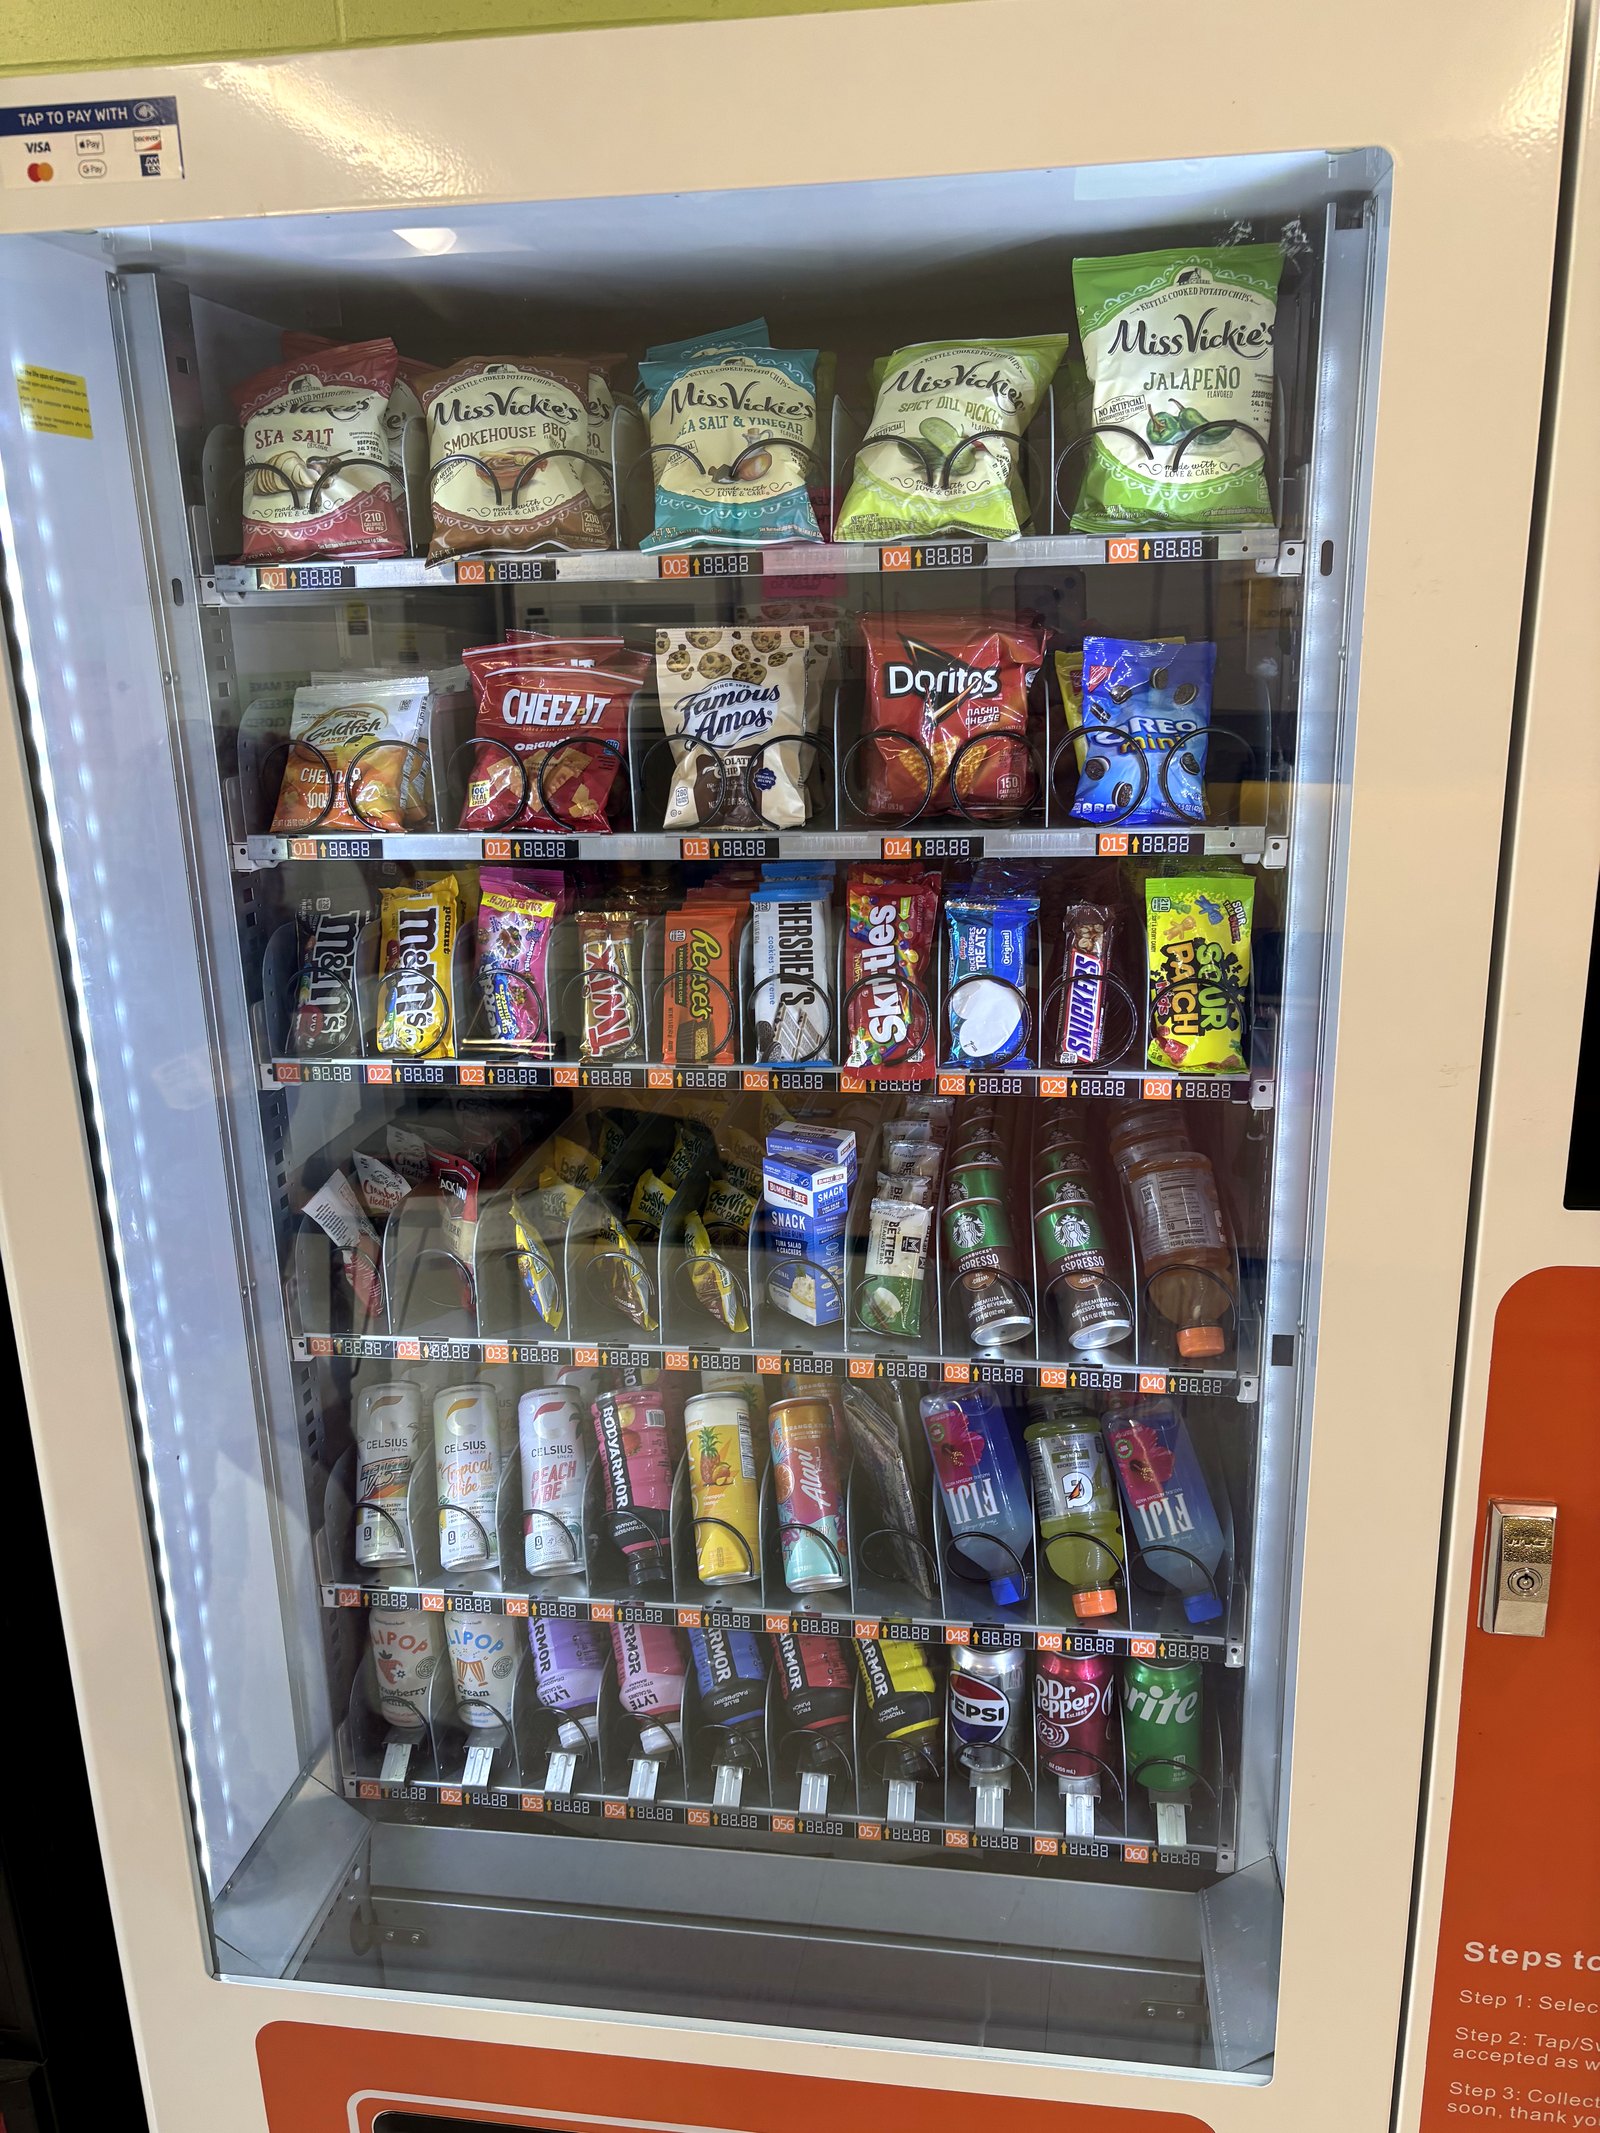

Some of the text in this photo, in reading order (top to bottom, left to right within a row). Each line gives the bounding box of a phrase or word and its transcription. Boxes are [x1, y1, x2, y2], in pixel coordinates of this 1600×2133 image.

[18, 106, 129, 127] TAP TO PAY WITH
[25, 141, 52, 154] VISA
[86, 141, 100, 150] Pay
[1140, 287, 1252, 312] KETTLE COOKED POTATO CHIPS
[1107, 305, 1274, 358] Miss Vickie's
[882, 367, 952, 396] Miss
[1143, 365, 1241, 392] JALAPEÑO
[670, 380, 814, 426] Miss Vickie's
[1206, 390, 1234, 400] FLAVORED
[434, 386, 580, 426] Miss Vickie's
[897, 396, 1003, 426] SPICY DILL PICKLE
[1098, 397, 1145, 418] NO ARTIFICIAL
[698, 415, 729, 432] SALT
[732, 415, 746, 428] &
[747, 416, 804, 437] VINEGAR
[254, 428, 334, 450] SEA SALT
[443, 422, 567, 459] SMOKEHOUSE BBQ
[365, 512, 382, 523] 210
[882, 546, 973, 566] 004 88.88
[1109, 539, 1203, 560] 005 88.88
[459, 562, 542, 580] 002 88.88
[663, 556, 749, 574] 003 88.88
[262, 570, 342, 587] 001 88.88
[888, 664, 999, 694] Doritos
[502, 687, 612, 727] CHEEZ-IT
[673, 682, 782, 732] Famous
[307, 718, 381, 743] Goldfish
[684, 705, 773, 752] Amos
[1094, 715, 1198, 746] OREO
[1001, 776, 1019, 789] 150
[293, 841, 370, 858] 011 88.88
[486, 841, 566, 858] 012 88.88
[684, 840, 766, 857] 013 88.88
[884, 839, 970, 856] 014 88.88
[1100, 836, 1190, 854] 015 88.88
[1161, 897, 1170, 911] 210
[1233, 900, 1247, 927] SOUR
[441, 904, 452, 956] peanut
[523, 940, 536, 972] rainbow
[767, 935, 776, 965] cookies
[777, 902, 816, 1006] HERSHEY'S
[968, 926, 977, 972] RICE KRISPIES
[975, 927, 988, 969] TREATS
[1003, 930, 1012, 965] Original
[395, 904, 440, 1030] m&m's
[689, 928, 723, 1020] Reese's
[861, 904, 908, 1044] Skittles
[1166, 941, 1199, 1036] PATCH
[583, 947, 633, 1057] TWIX
[1067, 954, 1100, 1058] SNICKERS
[277, 1066, 300, 1081] 021
[368, 1067, 392, 1081] 022
[461, 1069, 485, 1083] 023
[555, 1070, 579, 1084] 024
[650, 1072, 673, 1086] 025
[745, 1074, 769, 1087] 026
[841, 1077, 866, 1090] 027
[940, 1078, 966, 1092] 028
[1041, 1080, 1067, 1095] 029
[1145, 1082, 1171, 1096] 030
[768, 1183, 808, 1205] BUMBLE BEE
[818, 1184, 844, 1203] SNACK
[771, 1211, 806, 1231] SNACK
[775, 1239, 802, 1250] TUNA SALAD
[883, 1221, 900, 1265] BETTER
[958, 1253, 1000, 1273] ESPRESSO
[1060, 1256, 1105, 1273] ESPRESSO
[397, 1342, 421, 1357] 032
[486, 1348, 509, 1360] 033
[575, 1350, 599, 1364] 034
[666, 1354, 690, 1368] 035
[757, 1357, 781, 1371] 036
[851, 1360, 875, 1375] 037
[945, 1366, 970, 1380] 038
[1041, 1370, 1067, 1385] 039
[1140, 1376, 1166, 1390] 040
[366, 1438, 408, 1450] CELSIUS
[444, 1440, 487, 1455] CELSIUS
[531, 1445, 573, 1457] CELSIUS
[602, 1405, 629, 1509] BODYARMOR
[441, 1453, 493, 1484] Tropical
[530, 1460, 577, 1489] PEACH
[800, 1446, 832, 1508] Alani
[446, 1476, 480, 1499] Vibe
[530, 1481, 563, 1508] VIBE
[946, 1477, 1001, 1525] FIJI
[1137, 1493, 1195, 1542] FIJI
[422, 1596, 445, 1609] 042
[506, 1601, 529, 1614] 043
[591, 1606, 614, 1620] 044
[678, 1611, 701, 1625] 045
[766, 1617, 789, 1631] 046
[855, 1623, 878, 1637] 047
[945, 1629, 969, 1644] 048
[1038, 1634, 1062, 1649] 049
[1131, 1640, 1156, 1655] 050
[457, 1683, 491, 1698] Cream
[543, 1688, 571, 1706] LYTE
[1035, 1674, 1095, 1720] Pepper
[1048, 1678, 1077, 1702] Dr
[628, 1693, 660, 1711] LYTE
[1127, 1685, 1198, 1725] rite
[1041, 1722, 1055, 1741] 23
[441, 1790, 463, 1803] 052
[522, 1797, 544, 1810] 053
[604, 1804, 627, 1818] 054
[688, 1811, 711, 1824] 055
[772, 1818, 795, 1831] 056
[859, 1825, 881, 1838] 057
[945, 1832, 969, 1846] 058
[1034, 1840, 1058, 1855] 059
[1125, 1847, 1149, 1862] 060
[1463, 1941, 1600, 1972] Steps to
[1459, 1989, 1599, 2014] Step 1: Selec
[1455, 2026, 1503, 2046] Step
[1508, 2031, 1528, 2046] 2:
[1452, 2048, 1579, 2069] accepted as
[1449, 2081, 1497, 2101] Step
[1502, 2086, 1521, 2101] 3:
[1447, 2101, 1503, 2119] soon,
[1509, 2105, 1567, 2125] thank
